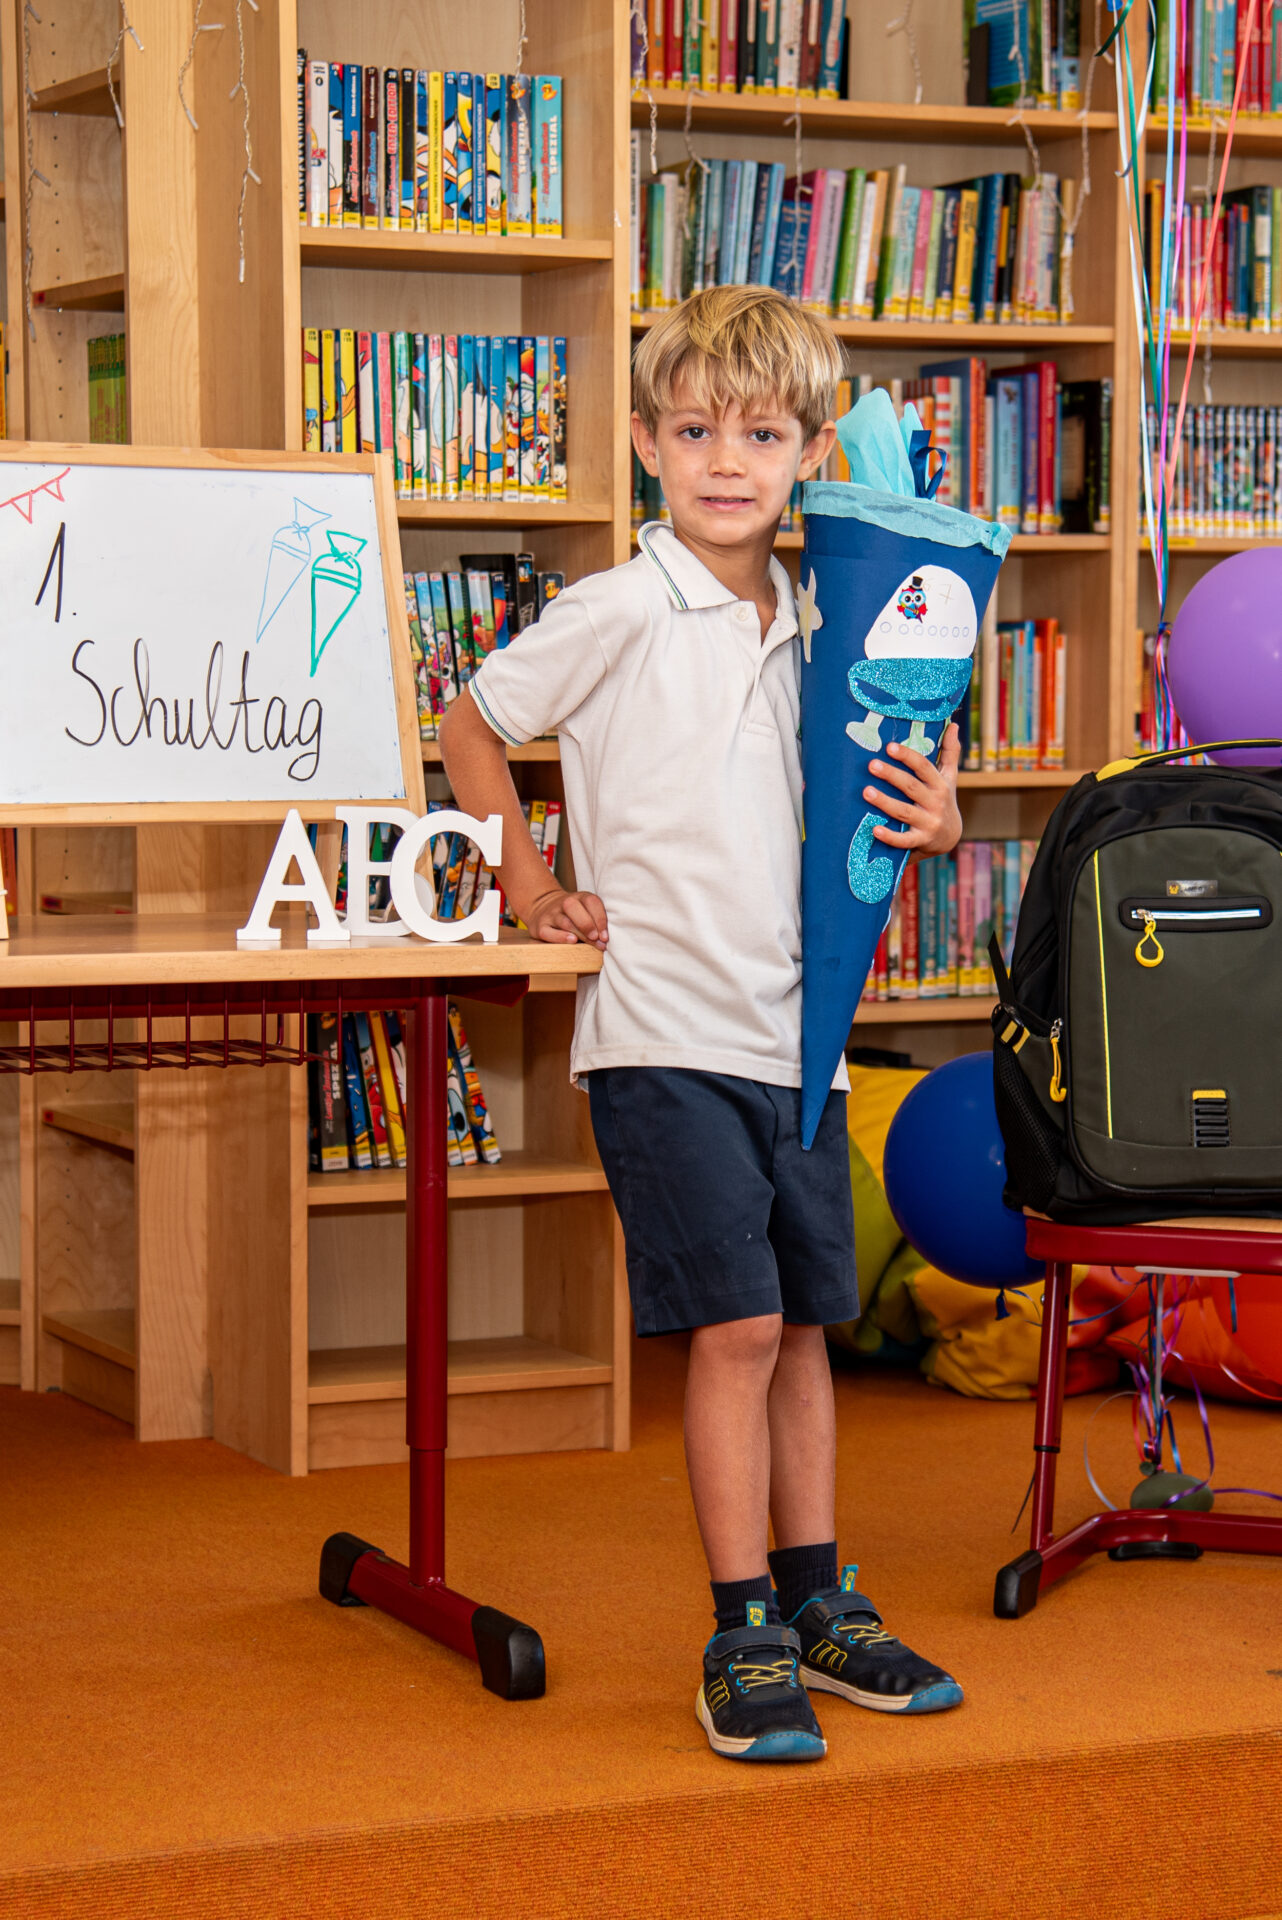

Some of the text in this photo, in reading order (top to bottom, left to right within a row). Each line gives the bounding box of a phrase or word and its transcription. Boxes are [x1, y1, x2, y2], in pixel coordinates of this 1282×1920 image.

[549, 115, 558, 175] SPEZIAL
[35, 521, 77, 623] 1.
[65, 637, 324, 781] Schultag
[236, 806, 504, 942] ABC
[330, 1041, 341, 1100] SPEZAL
